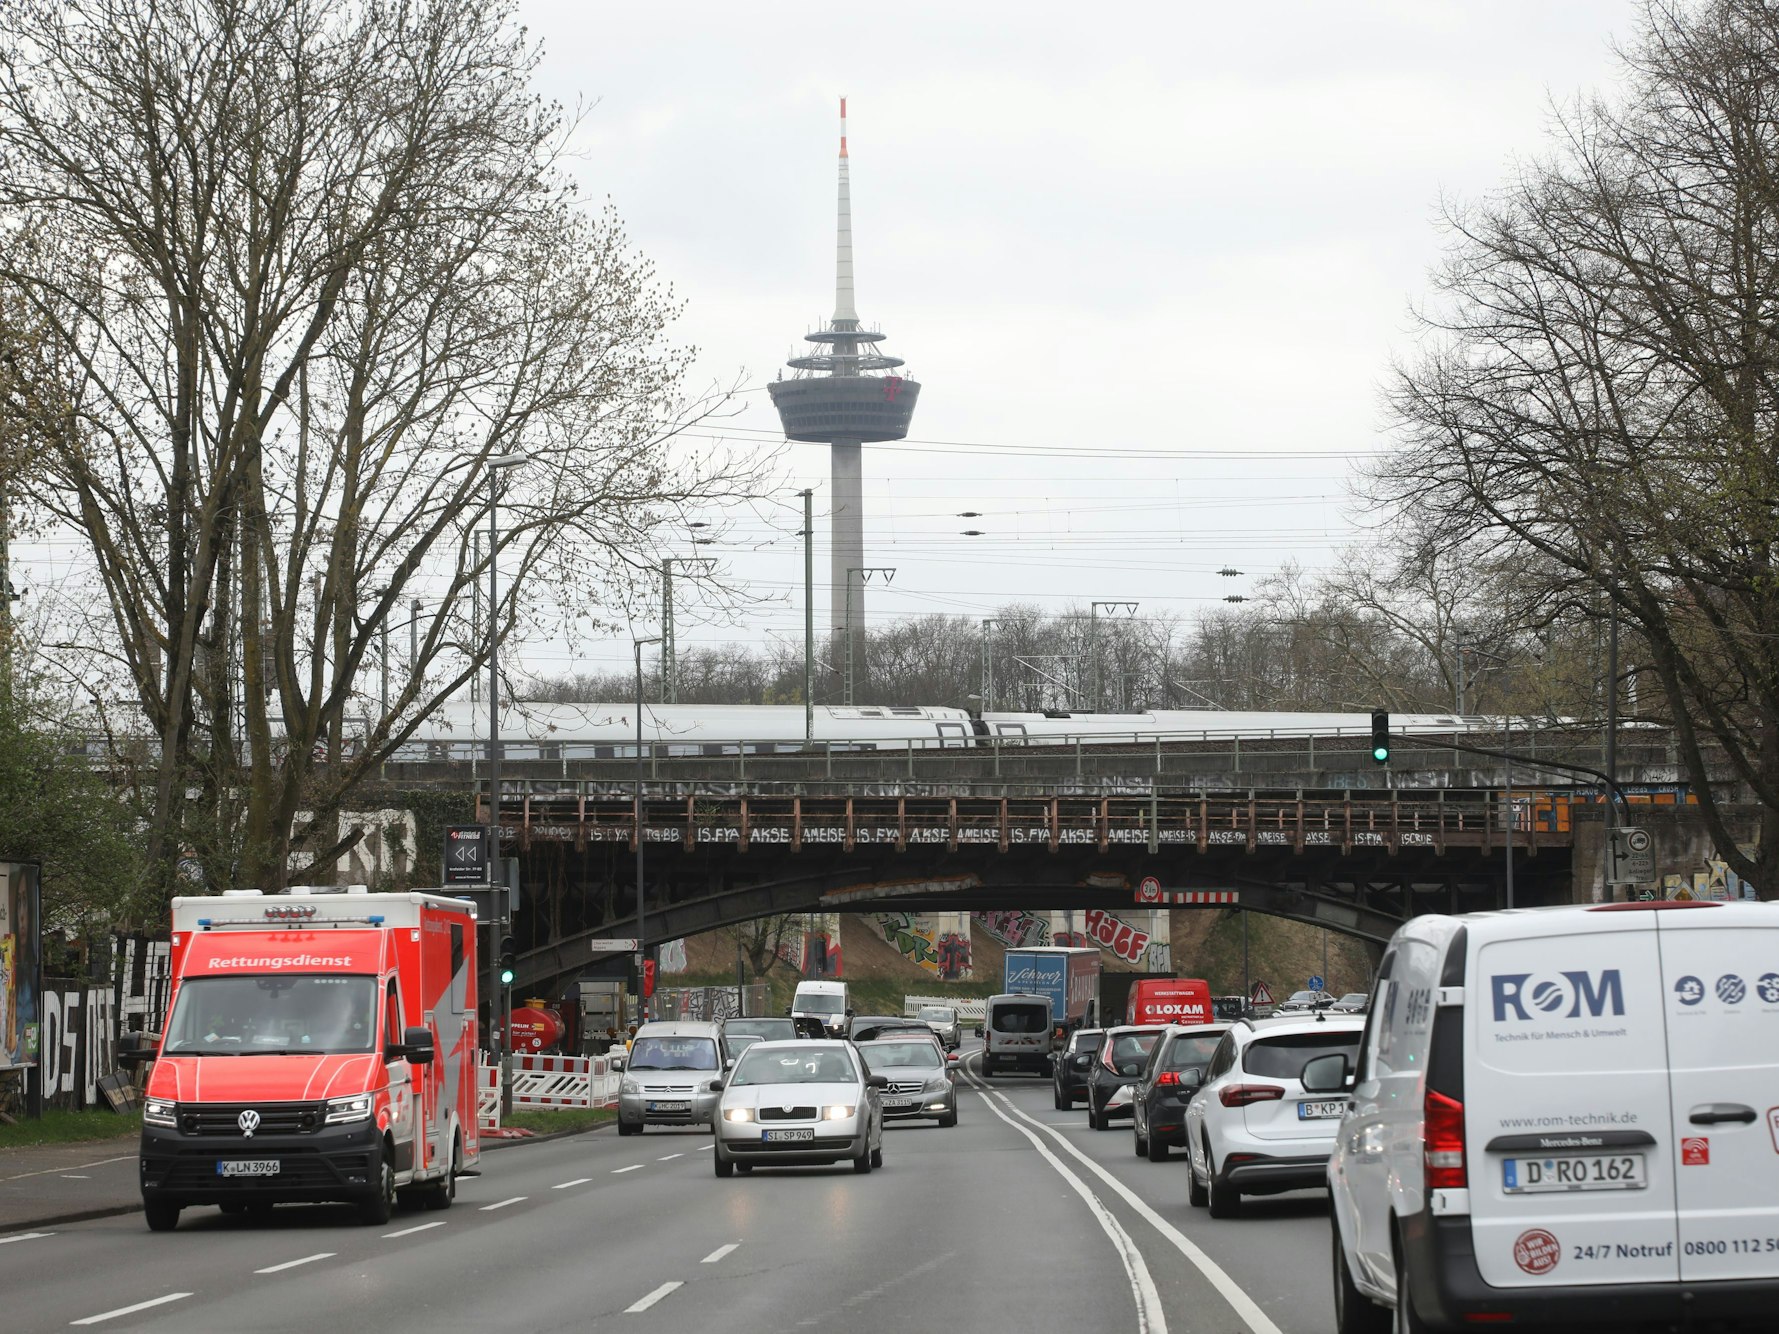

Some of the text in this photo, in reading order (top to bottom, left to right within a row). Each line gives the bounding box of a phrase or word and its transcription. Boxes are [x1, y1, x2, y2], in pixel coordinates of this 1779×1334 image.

[208, 954, 352, 969] Rettungsdienst
[1491, 969, 1625, 1022] ROM
[1156, 1004, 1204, 1014] LOXAM
[1494, 1028, 1627, 1042] Technik für Mensch & Umwelt
[1305, 1105, 1313, 1115] B
[1321, 1104, 1335, 1115] KP
[1499, 1112, 1638, 1128] www.rom-technik.de
[784, 1132, 796, 1140] SP
[797, 1131, 812, 1140] 949
[1540, 1138, 1603, 1148] Mercedes-Benz
[223, 1162, 230, 1173] K
[1527, 1161, 1541, 1183] D
[1593, 1157, 1635, 1181] 162
[1573, 1238, 1779, 1260] 24/7 Notruf 0800 112 5
